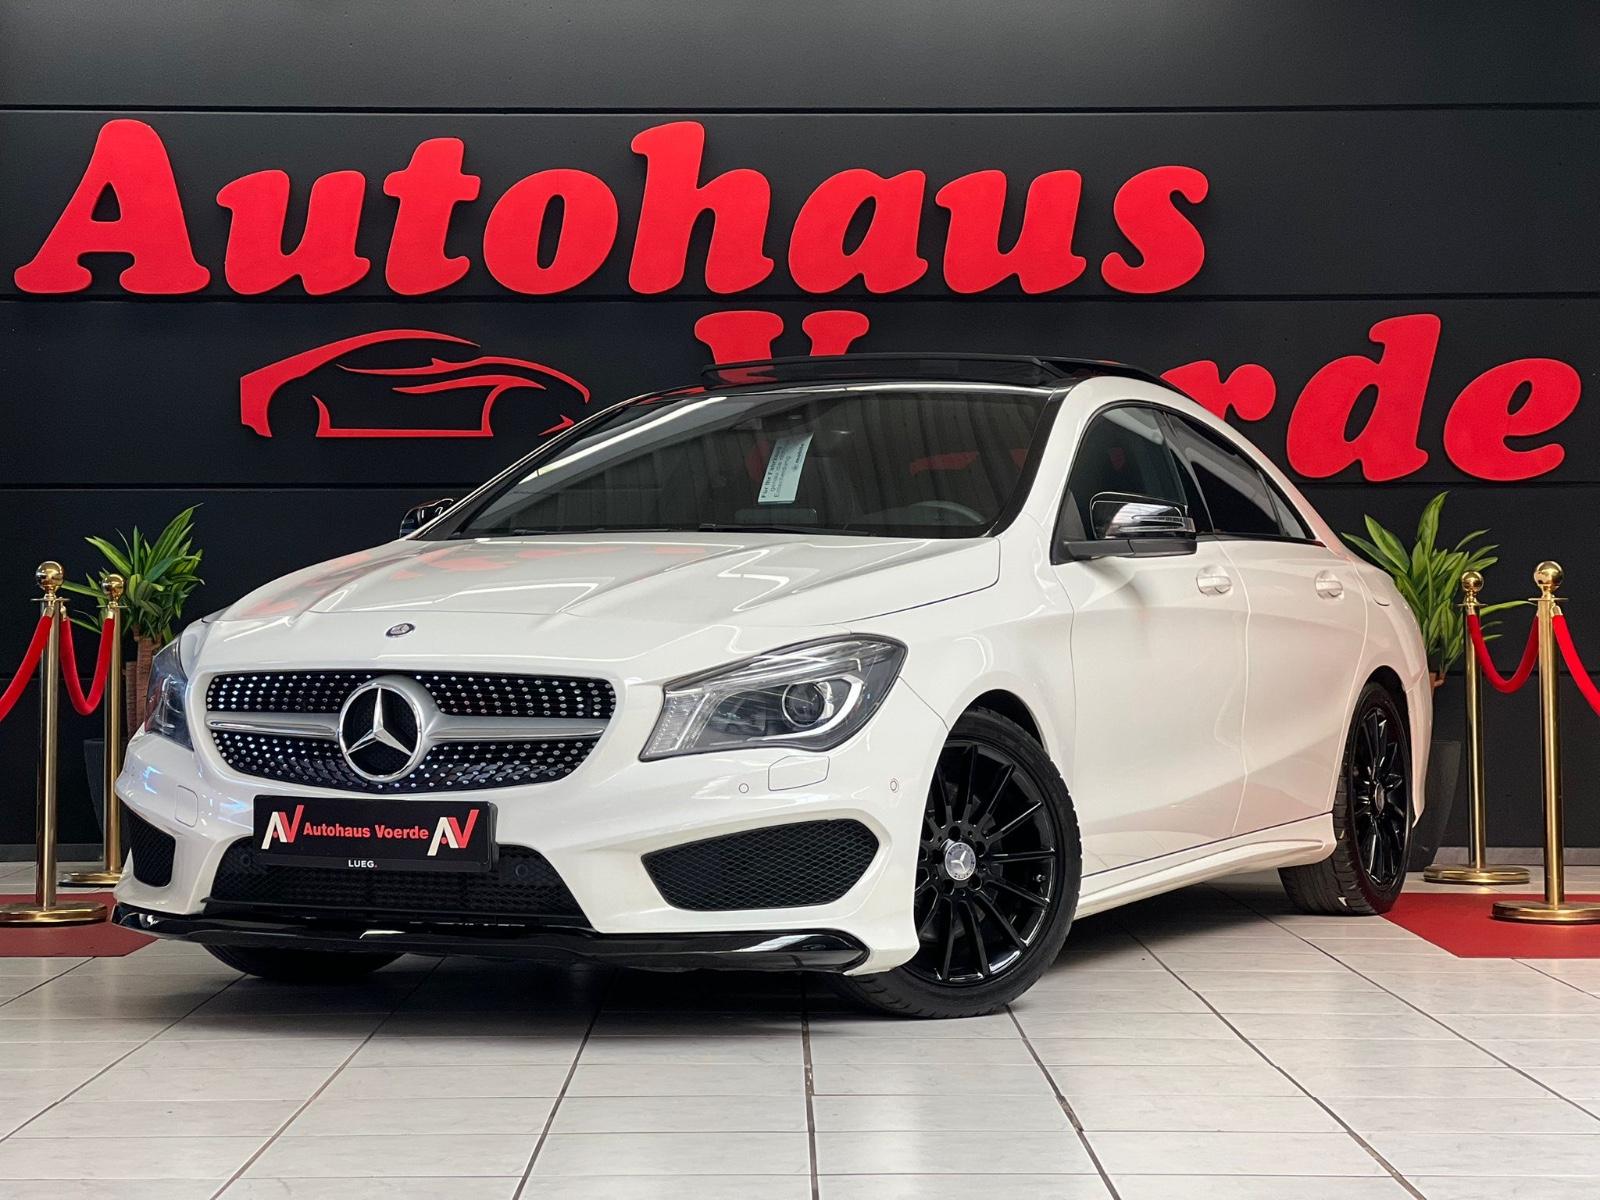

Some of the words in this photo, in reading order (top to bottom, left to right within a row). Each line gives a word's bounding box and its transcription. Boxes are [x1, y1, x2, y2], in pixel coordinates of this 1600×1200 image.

[14, 119, 1210, 296] Autohaus
[694, 310, 1582, 482] rde
[303, 822, 371, 838] Autohaus
[375, 824, 429, 840] Voerde
